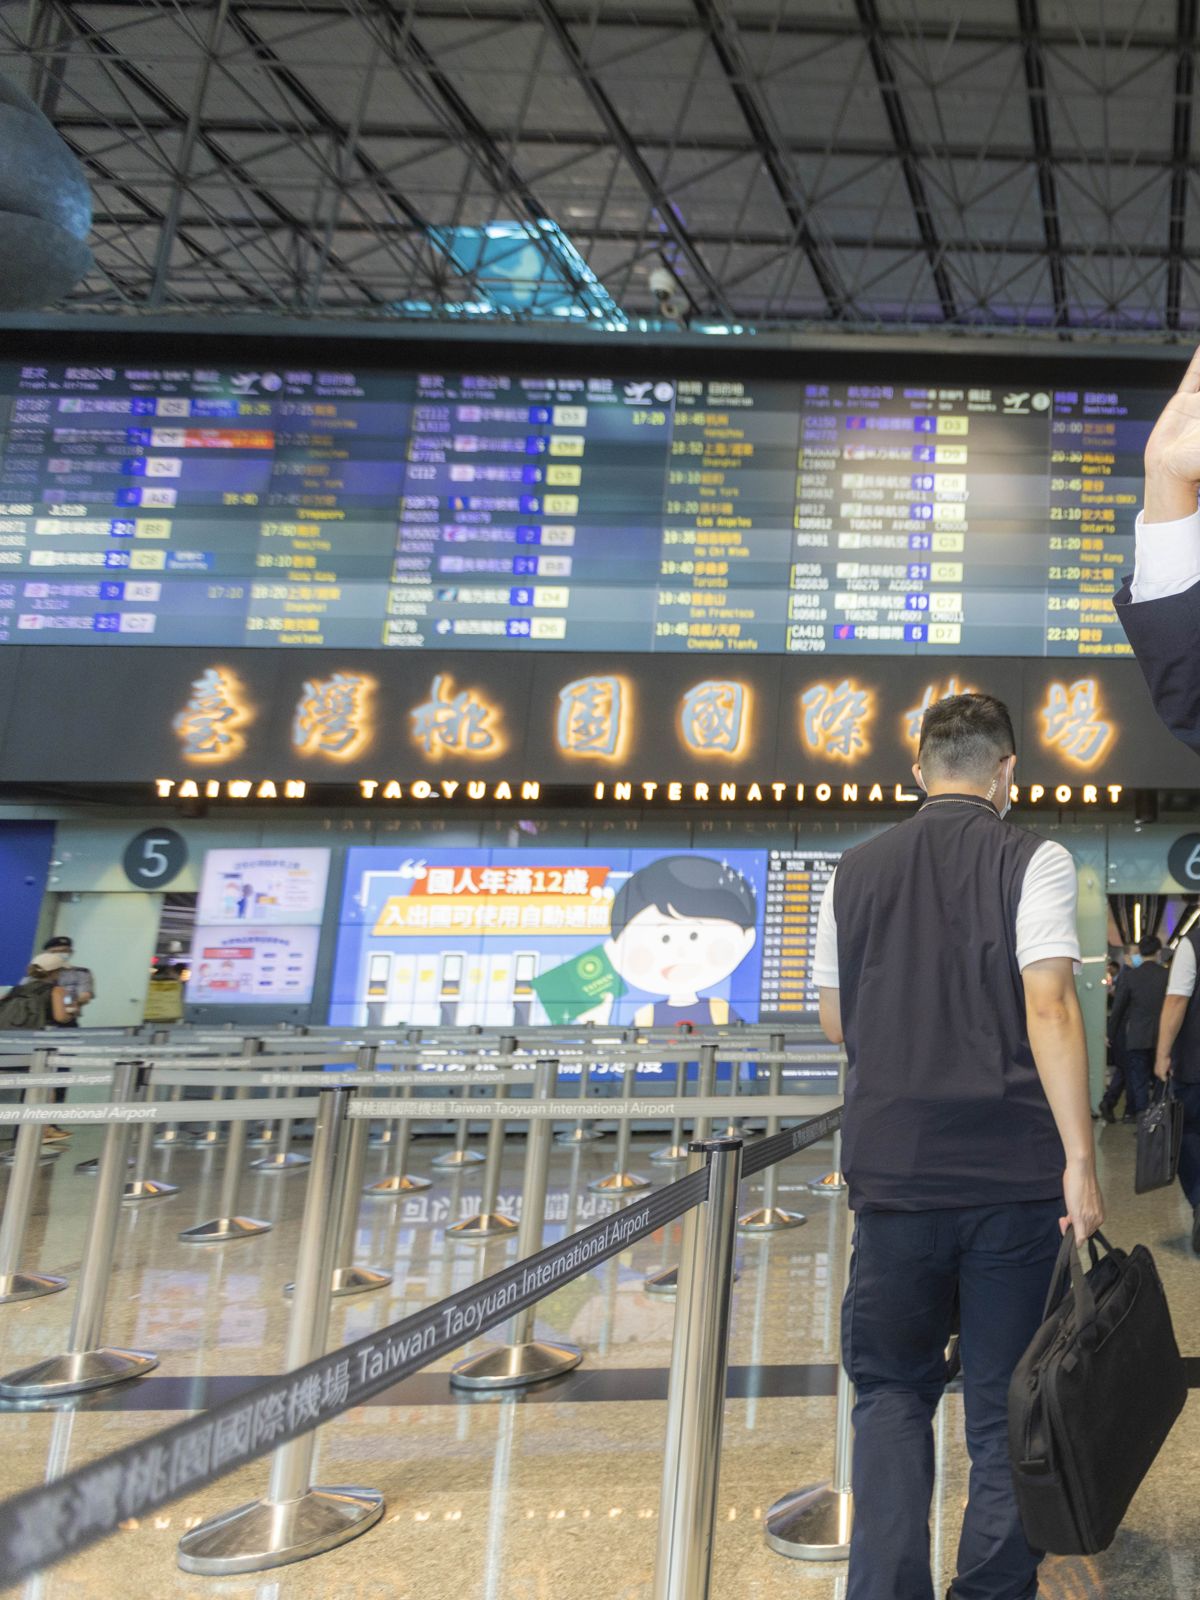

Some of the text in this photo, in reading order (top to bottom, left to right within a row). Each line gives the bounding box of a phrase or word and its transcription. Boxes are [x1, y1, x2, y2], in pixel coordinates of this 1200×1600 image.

[912, 536, 929, 548] 21
[1050, 537, 1081, 550] 21:20
[911, 565, 928, 578] 21
[1049, 567, 1080, 580] 21:20
[1048, 628, 1079, 640] 22:30
[156, 778, 1123, 803] TAIWAN TAOYUAN INTERNATIONAL RPORT
[139, 839, 171, 877] 5
[23, 1105, 107, 1120] International
[109, 1106, 158, 1122] Airport
[349, 1101, 675, 1117] 灣桃園國際機場 Taiwan Taoyuan International Airport
[357, 1324, 437, 1385] Taiwan
[442, 1282, 518, 1341] Taoyuan
[522, 1234, 609, 1296] International
[610, 1207, 651, 1245] Airport
